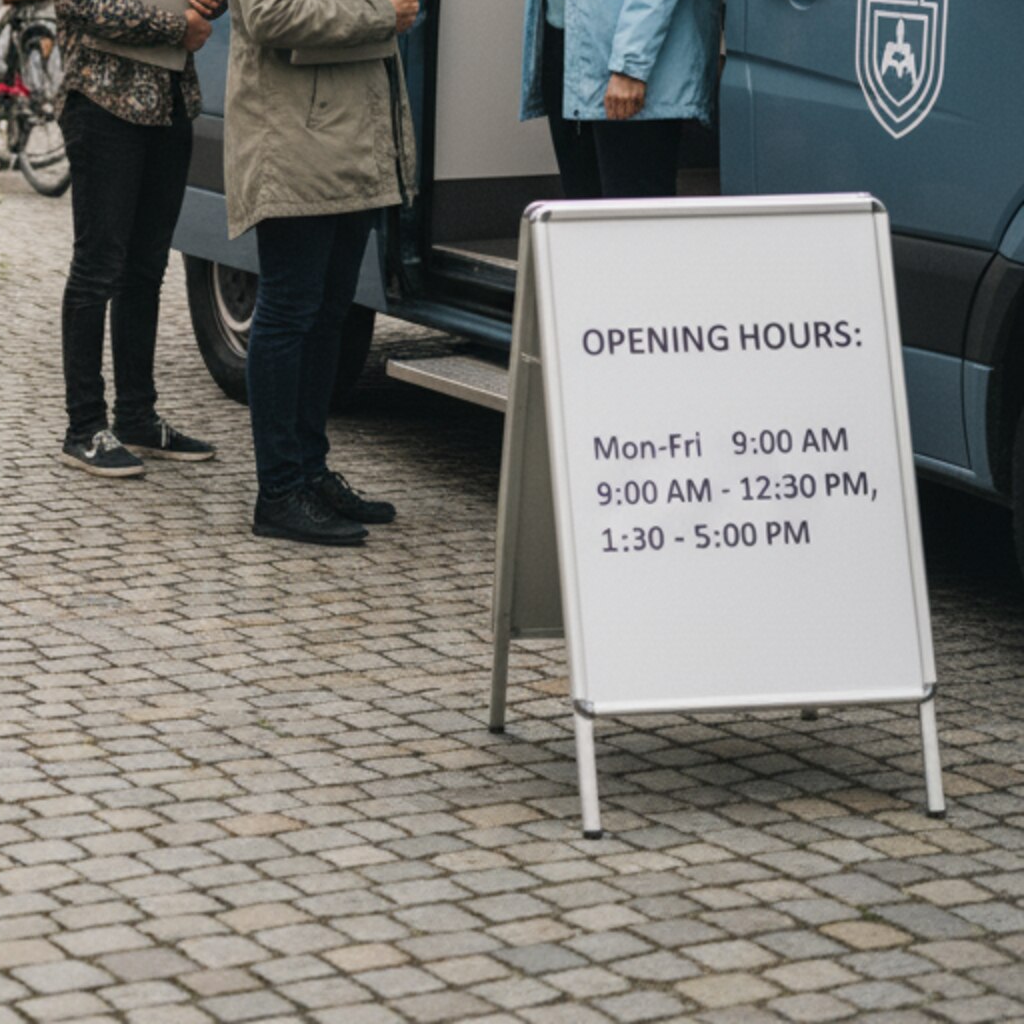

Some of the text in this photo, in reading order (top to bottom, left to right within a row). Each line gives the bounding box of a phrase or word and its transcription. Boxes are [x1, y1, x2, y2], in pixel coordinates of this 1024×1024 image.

[582, 319, 863, 356] OPENING HOURS:
[593, 426, 849, 461] Mon-Fri 9:00 AM
[596, 479, 658, 507] 9:00
[666, 477, 713, 504] AM
[739, 473, 817, 501] 12:30
[824, 470, 878, 502] PM,
[601, 525, 665, 553] 1:30
[693, 521, 758, 550] 5:00
[765, 519, 811, 546] PM
